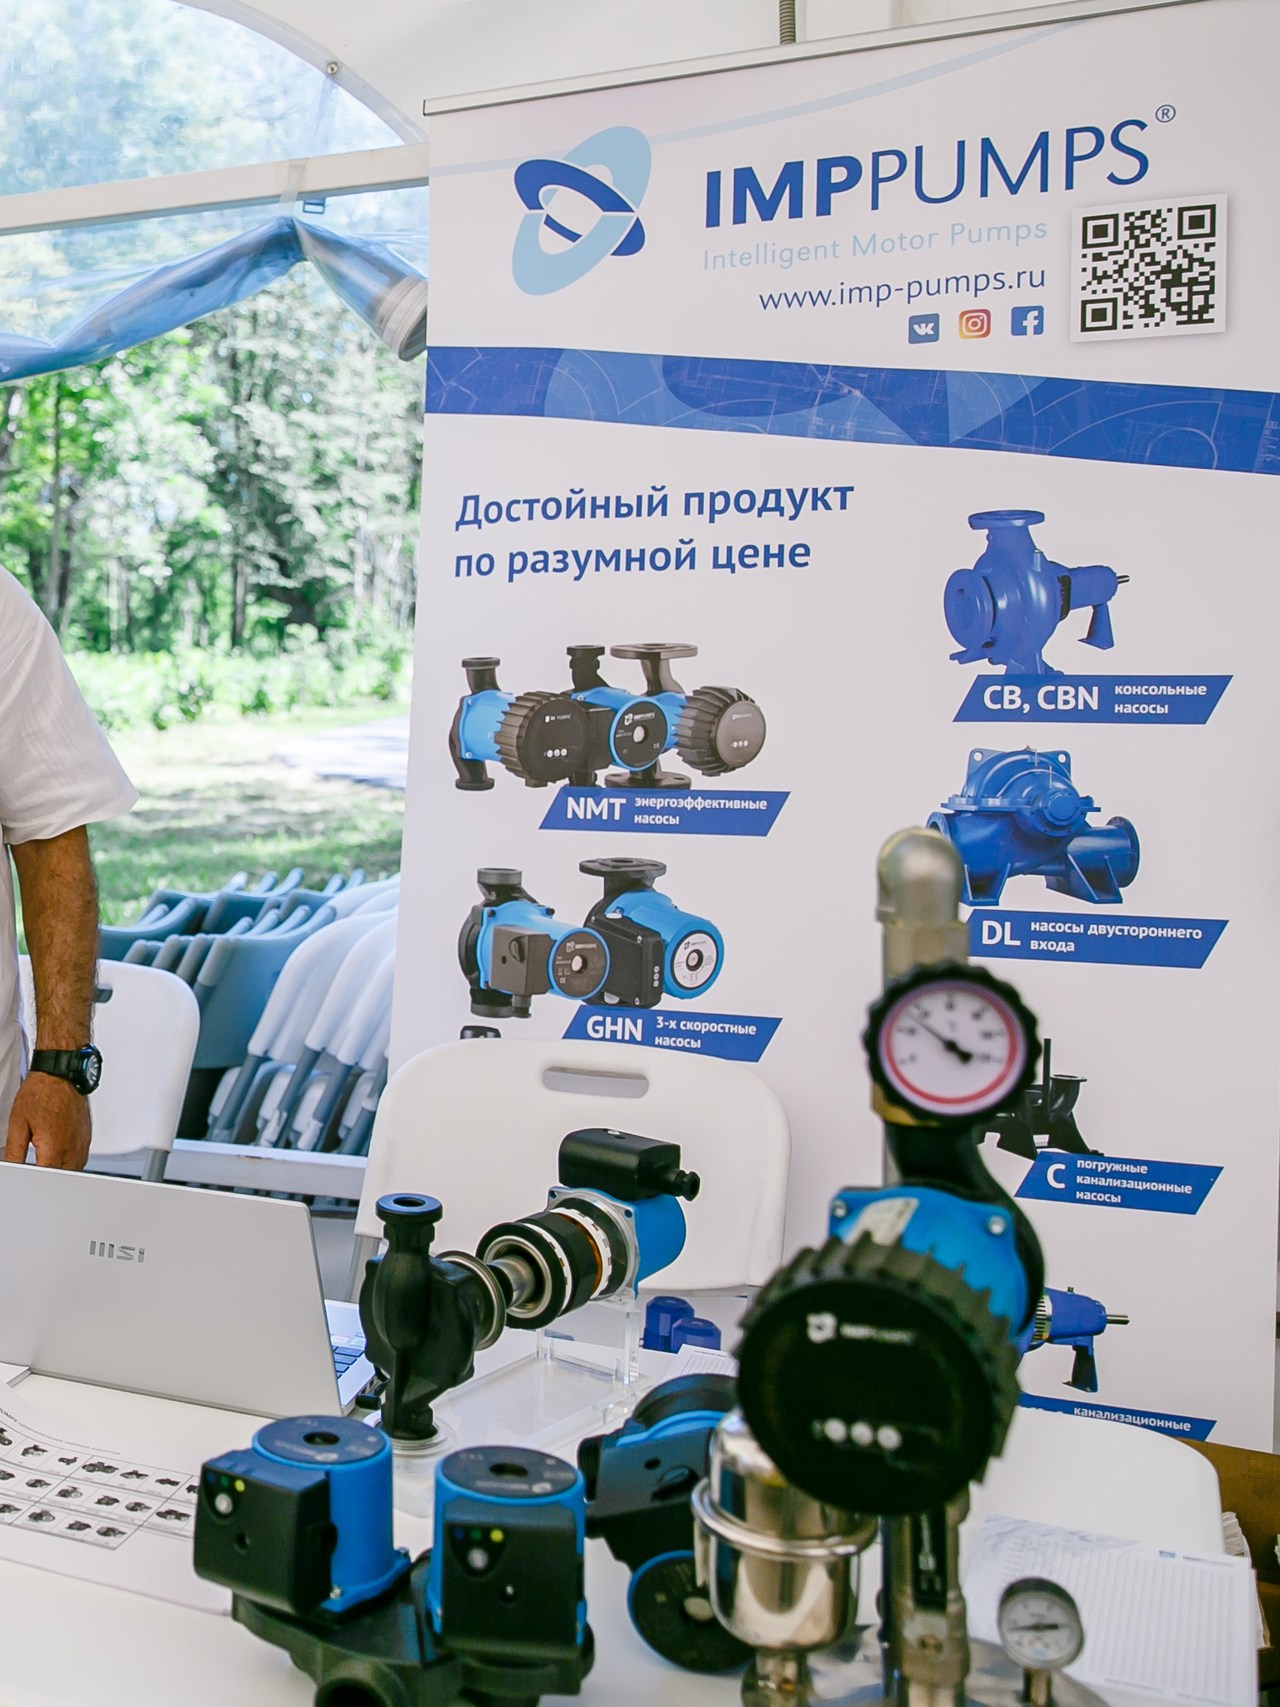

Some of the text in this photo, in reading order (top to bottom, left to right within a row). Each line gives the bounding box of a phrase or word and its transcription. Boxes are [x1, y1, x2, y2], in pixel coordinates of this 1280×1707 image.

[703, 220, 1048, 270] Intelligent Motor Pumps
[758, 269, 1046, 311] www.imp-pumps.ru
[455, 485, 855, 531] Достойный продукт
[454, 538, 811, 583] по разумной цене
[1037, 684, 1100, 711] CBN
[1114, 684, 1208, 697] консольные
[1114, 702, 1169, 714] насосы
[567, 797, 627, 820] NMT
[634, 796, 768, 812] энергоэффективные
[634, 814, 680, 825] насосы
[981, 919, 1022, 946] DL
[1030, 921, 1203, 940] насосы двустороннего
[1030, 940, 1075, 952] входа
[586, 1015, 643, 1041] GHN
[656, 1016, 757, 1035] 3-х скоростные
[654, 1036, 701, 1048] насосы
[1077, 1159, 1149, 1175] погружные
[1076, 1175, 1193, 1194] канализационные
[1075, 1191, 1122, 1203] насосы
[1073, 1406, 1192, 1432] канализационные
